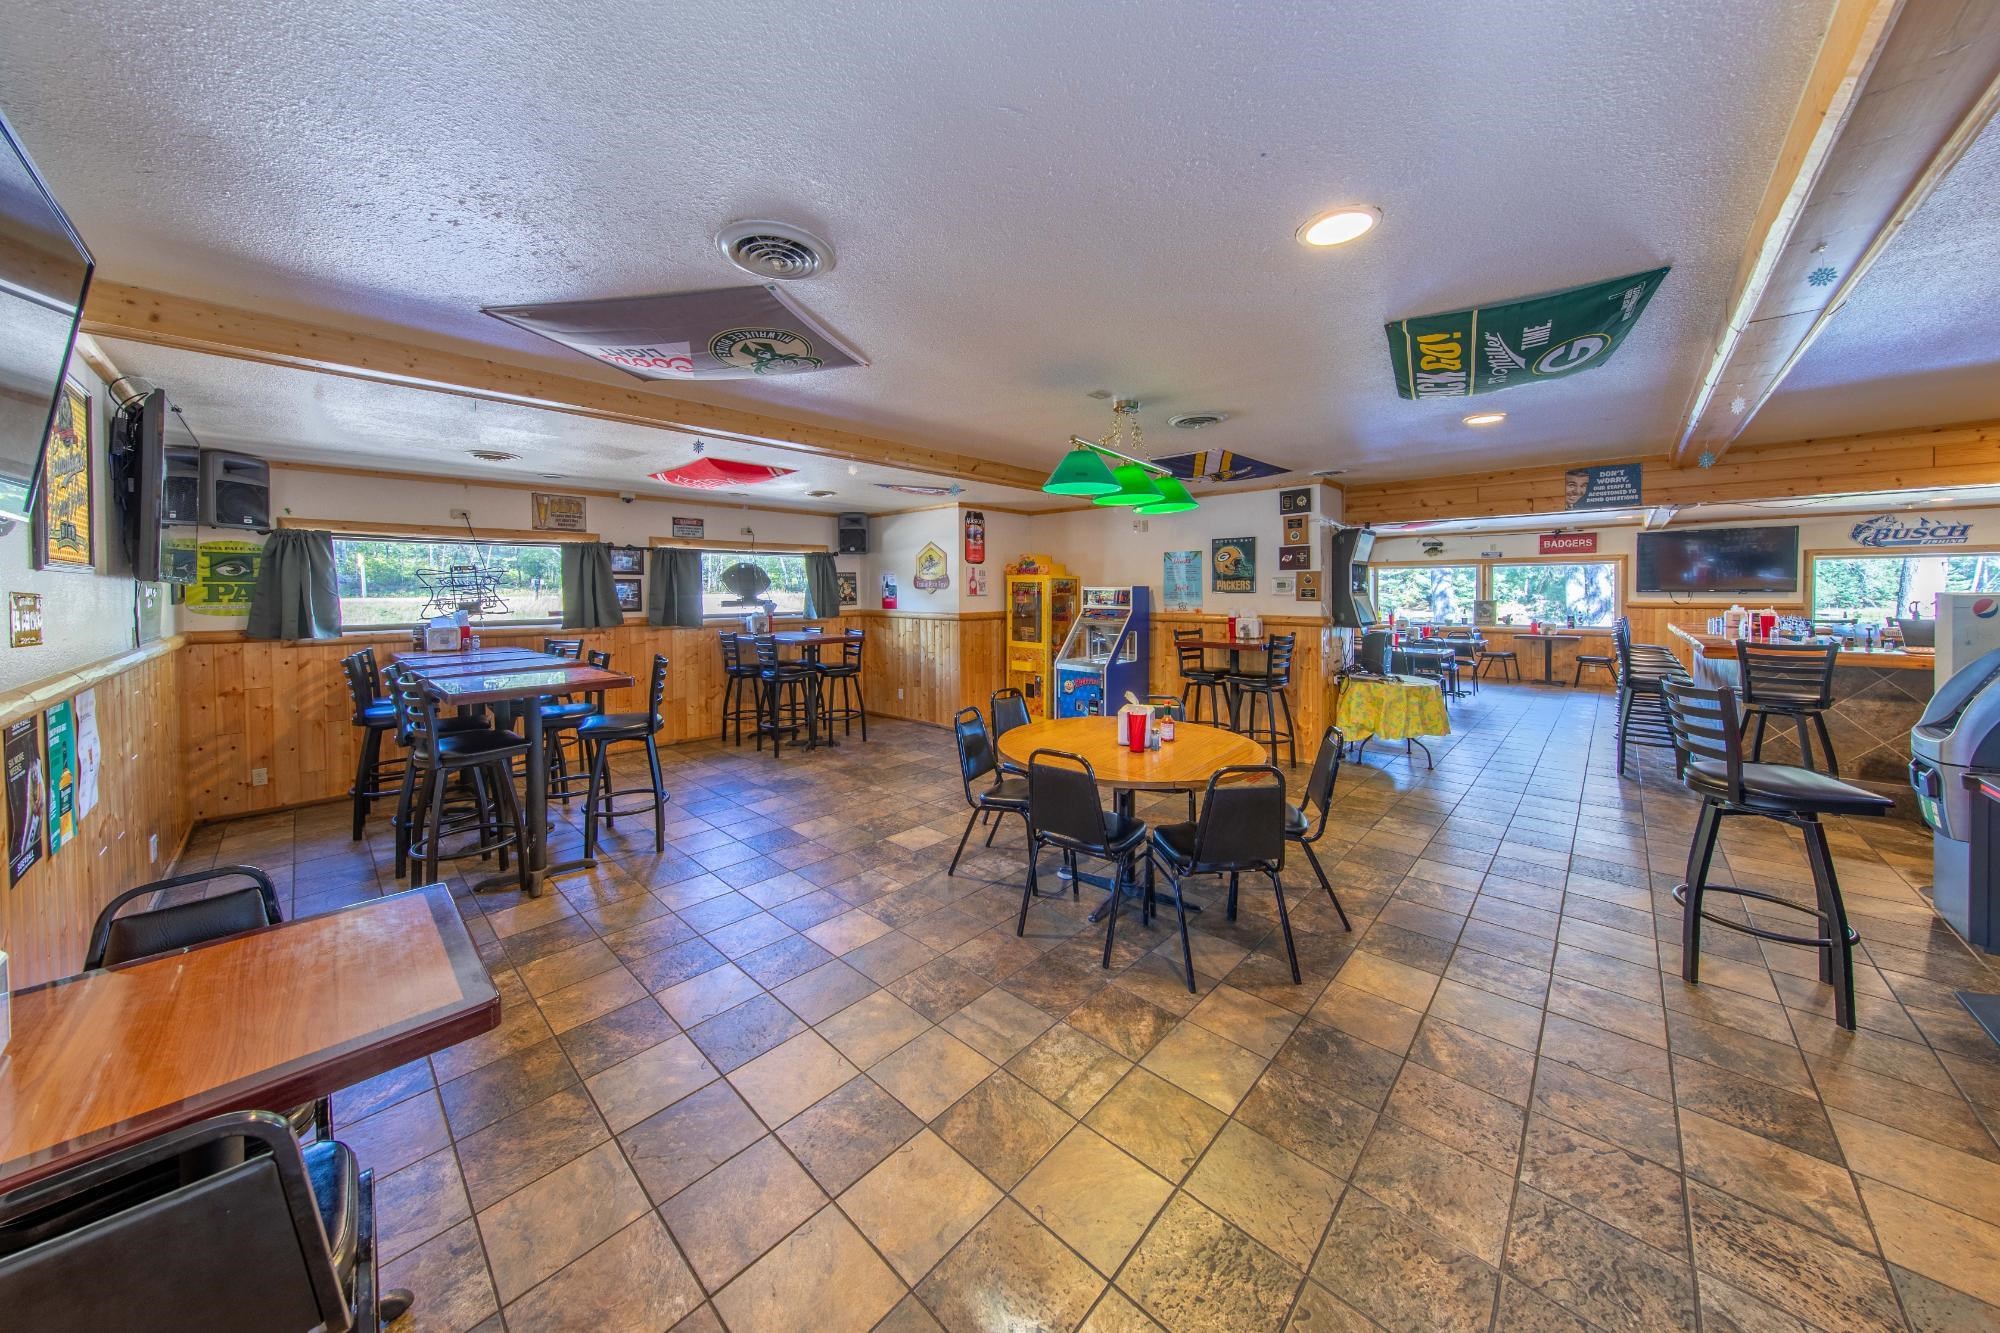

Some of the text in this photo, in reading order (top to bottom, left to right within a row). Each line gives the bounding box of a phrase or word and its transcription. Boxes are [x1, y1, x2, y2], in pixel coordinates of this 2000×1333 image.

[731, 331, 795, 344] MILWAUKEE
[1521, 319, 1553, 351] TIME.
[599, 347, 667, 358] LIGHT
[1416, 331, 1462, 371] GO!
[1484, 331, 1527, 376] Miller
[1599, 469, 1625, 478] DON'T
[1596, 476, 1630, 485] WORRY,
[1588, 489, 1628, 497] ACCUSTOMED
[1871, 524, 1974, 540] BUSCH
[1543, 538, 1593, 549] BADGERS
[1216, 580, 1251, 591] PACKERS
